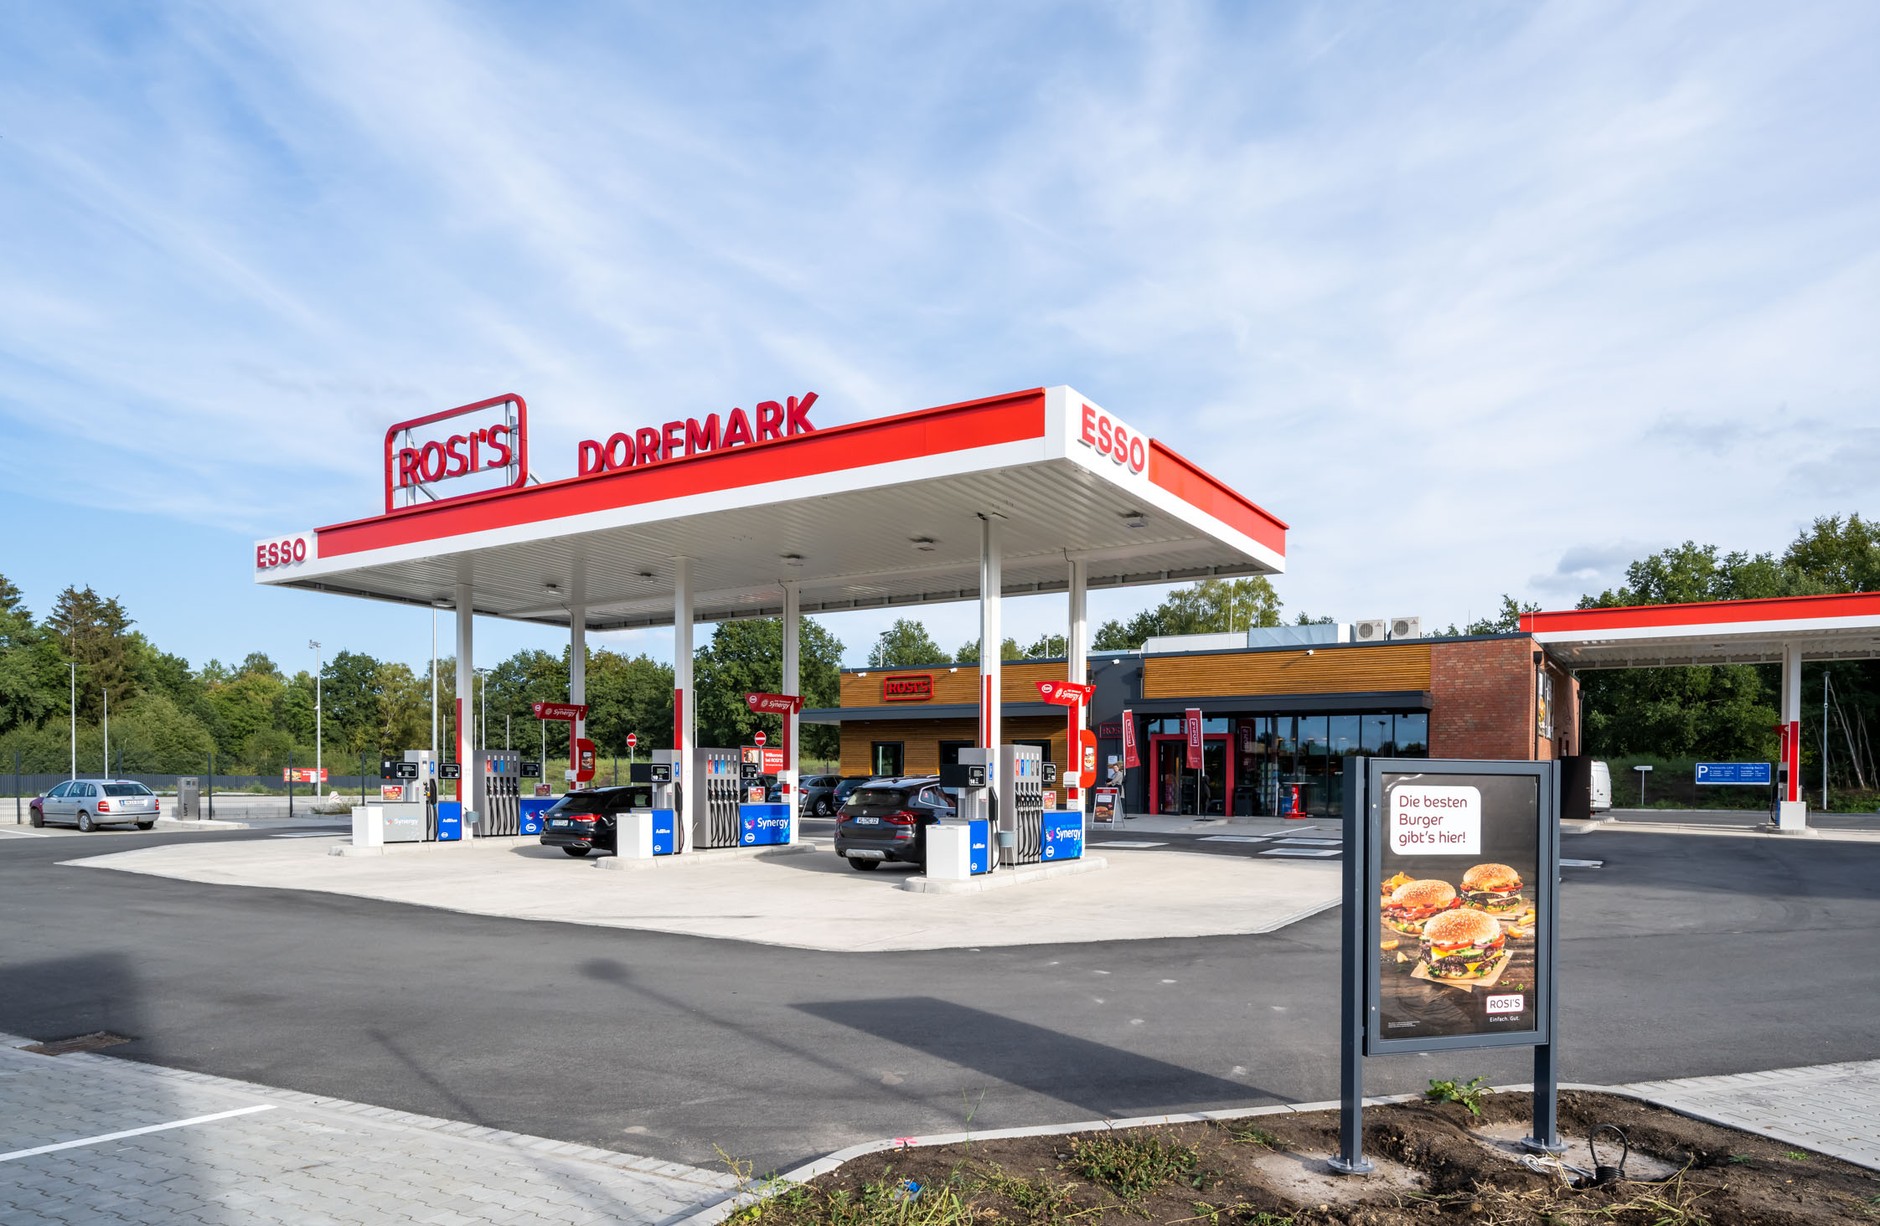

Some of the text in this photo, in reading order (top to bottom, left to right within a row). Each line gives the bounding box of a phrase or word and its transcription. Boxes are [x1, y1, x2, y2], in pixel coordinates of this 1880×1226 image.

[578, 391, 819, 477] DORFMARK
[1081, 403, 1145, 473] ESSO
[399, 424, 511, 488] ROSI'S
[257, 537, 306, 568] ESSO
[888, 681, 929, 693] ROSI'S
[769, 700, 791, 710] Synergy
[553, 709, 576, 717] Synergy
[1698, 765, 1708, 779] P
[1399, 795, 1467, 808] Die besten
[757, 817, 789, 830] Synergy
[1399, 813, 1444, 829] Burger
[1056, 827, 1081, 842] Synergy
[1439, 830, 1466, 844] hier!
[1489, 998, 1521, 1009] ROSI'S
